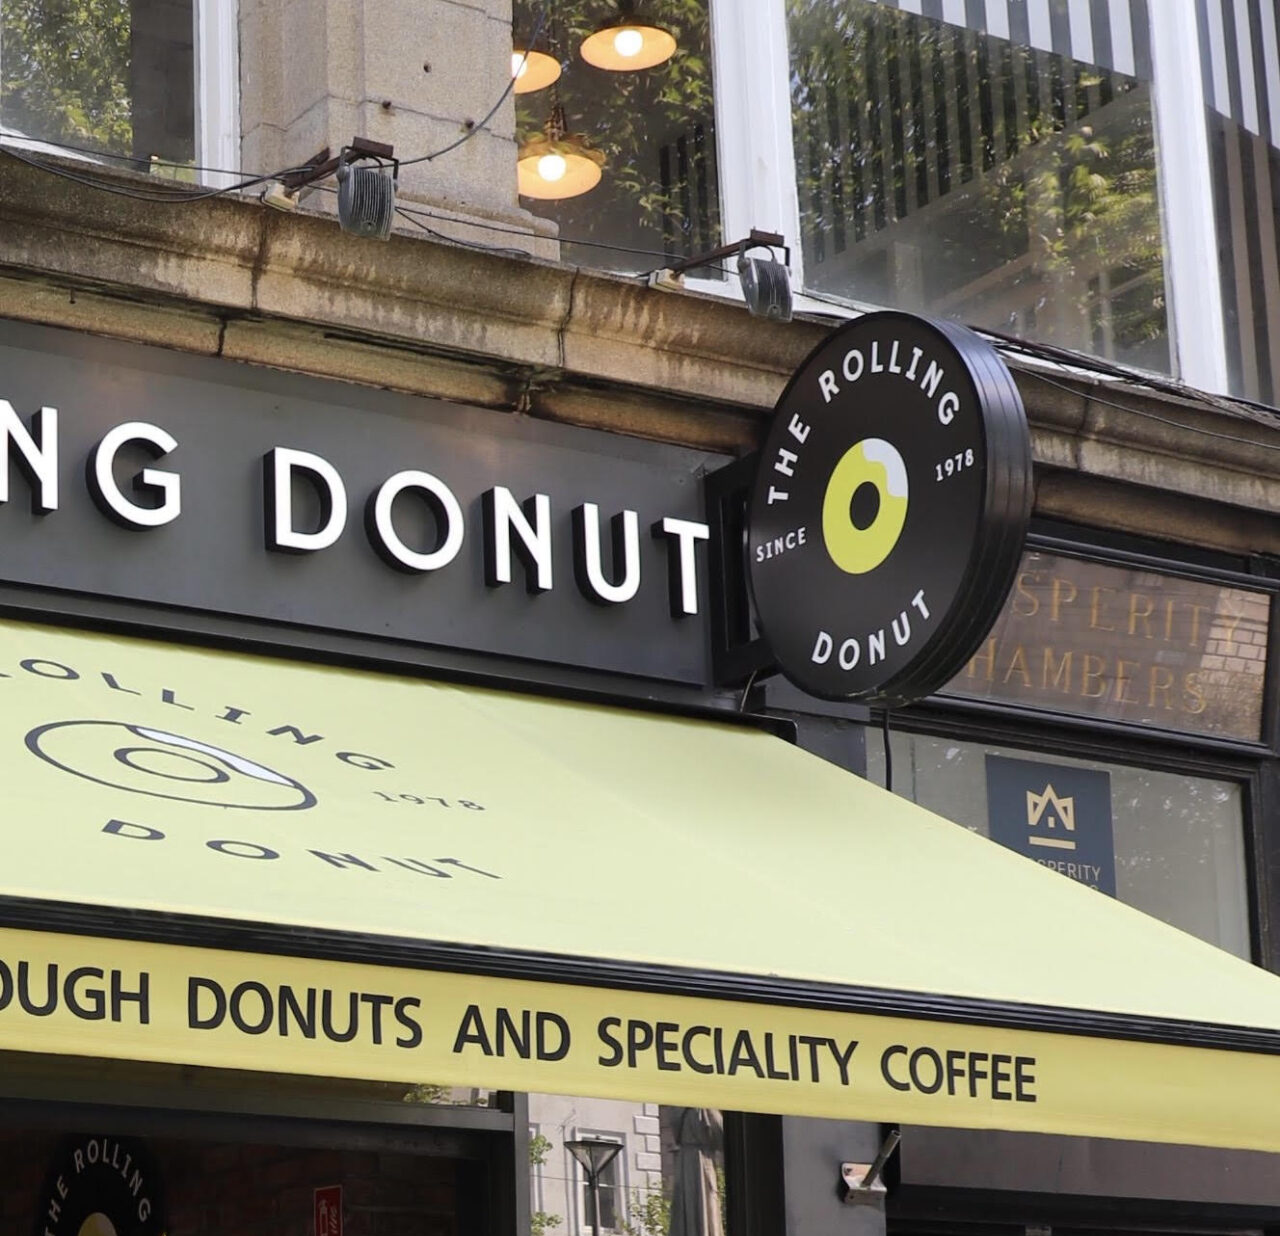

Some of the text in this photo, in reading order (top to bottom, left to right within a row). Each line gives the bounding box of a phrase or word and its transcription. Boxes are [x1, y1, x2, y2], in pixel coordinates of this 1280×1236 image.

[767, 339, 960, 506] THE ROLLING
[264, 446, 710, 617] DONUT
[755, 448, 975, 563] SINCE 1978
[811, 588, 932, 669] DONUT
[101, 818, 503, 880] DONUT
[372, 790, 486, 813] 1978
[186, 976, 423, 1050] DONUTS
[452, 1003, 571, 1063] AND
[598, 1016, 859, 1086] SPECIALITY
[879, 1043, 1038, 1103] COFFEE
[73, 1138, 152, 1224] ROLLING
